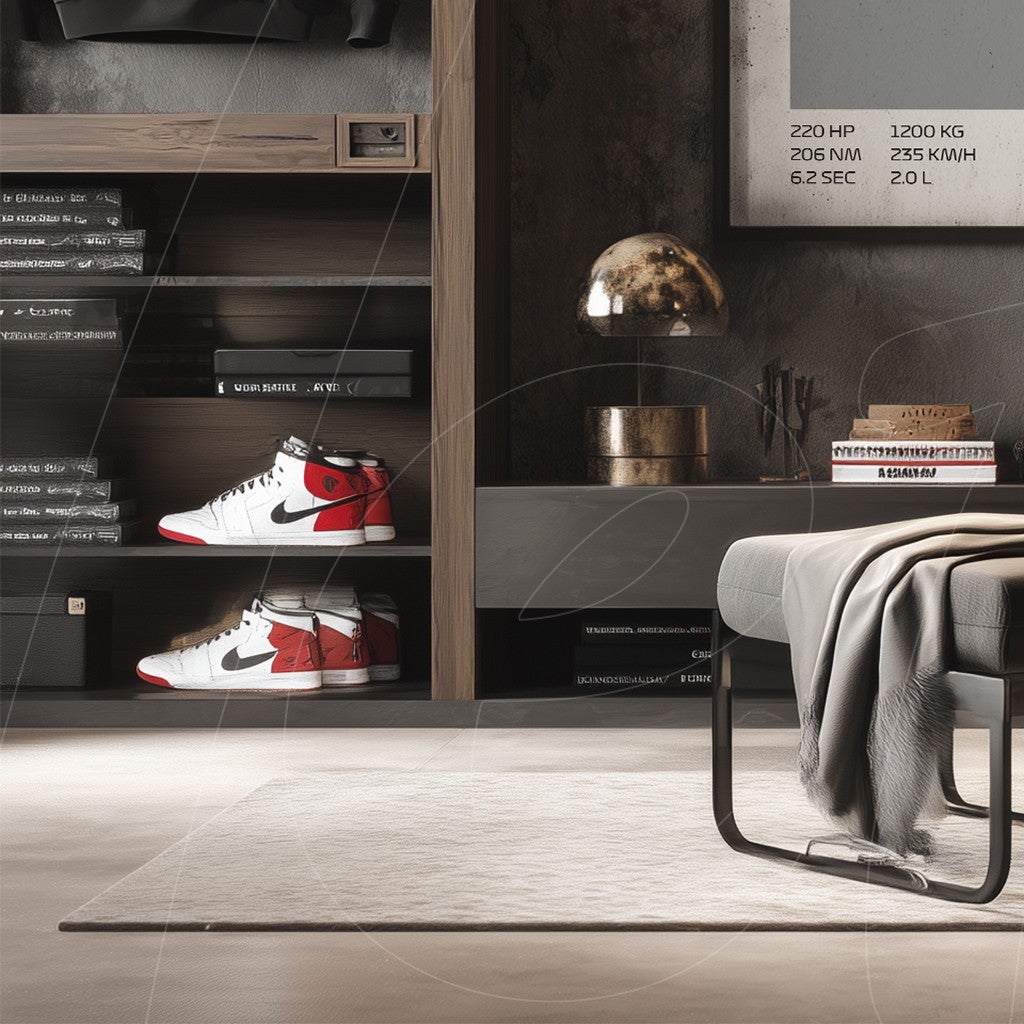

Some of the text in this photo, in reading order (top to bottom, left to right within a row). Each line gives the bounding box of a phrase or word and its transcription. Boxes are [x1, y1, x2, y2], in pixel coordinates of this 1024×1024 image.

[790, 124, 855, 138] 220 HP
[890, 124, 964, 139] 1200 KG
[790, 147, 862, 162] 206 NM
[890, 147, 976, 163] 235 KM/H
[790, 170, 856, 185] 6.2 SEC
[890, 170, 932, 185] 2.0 L
